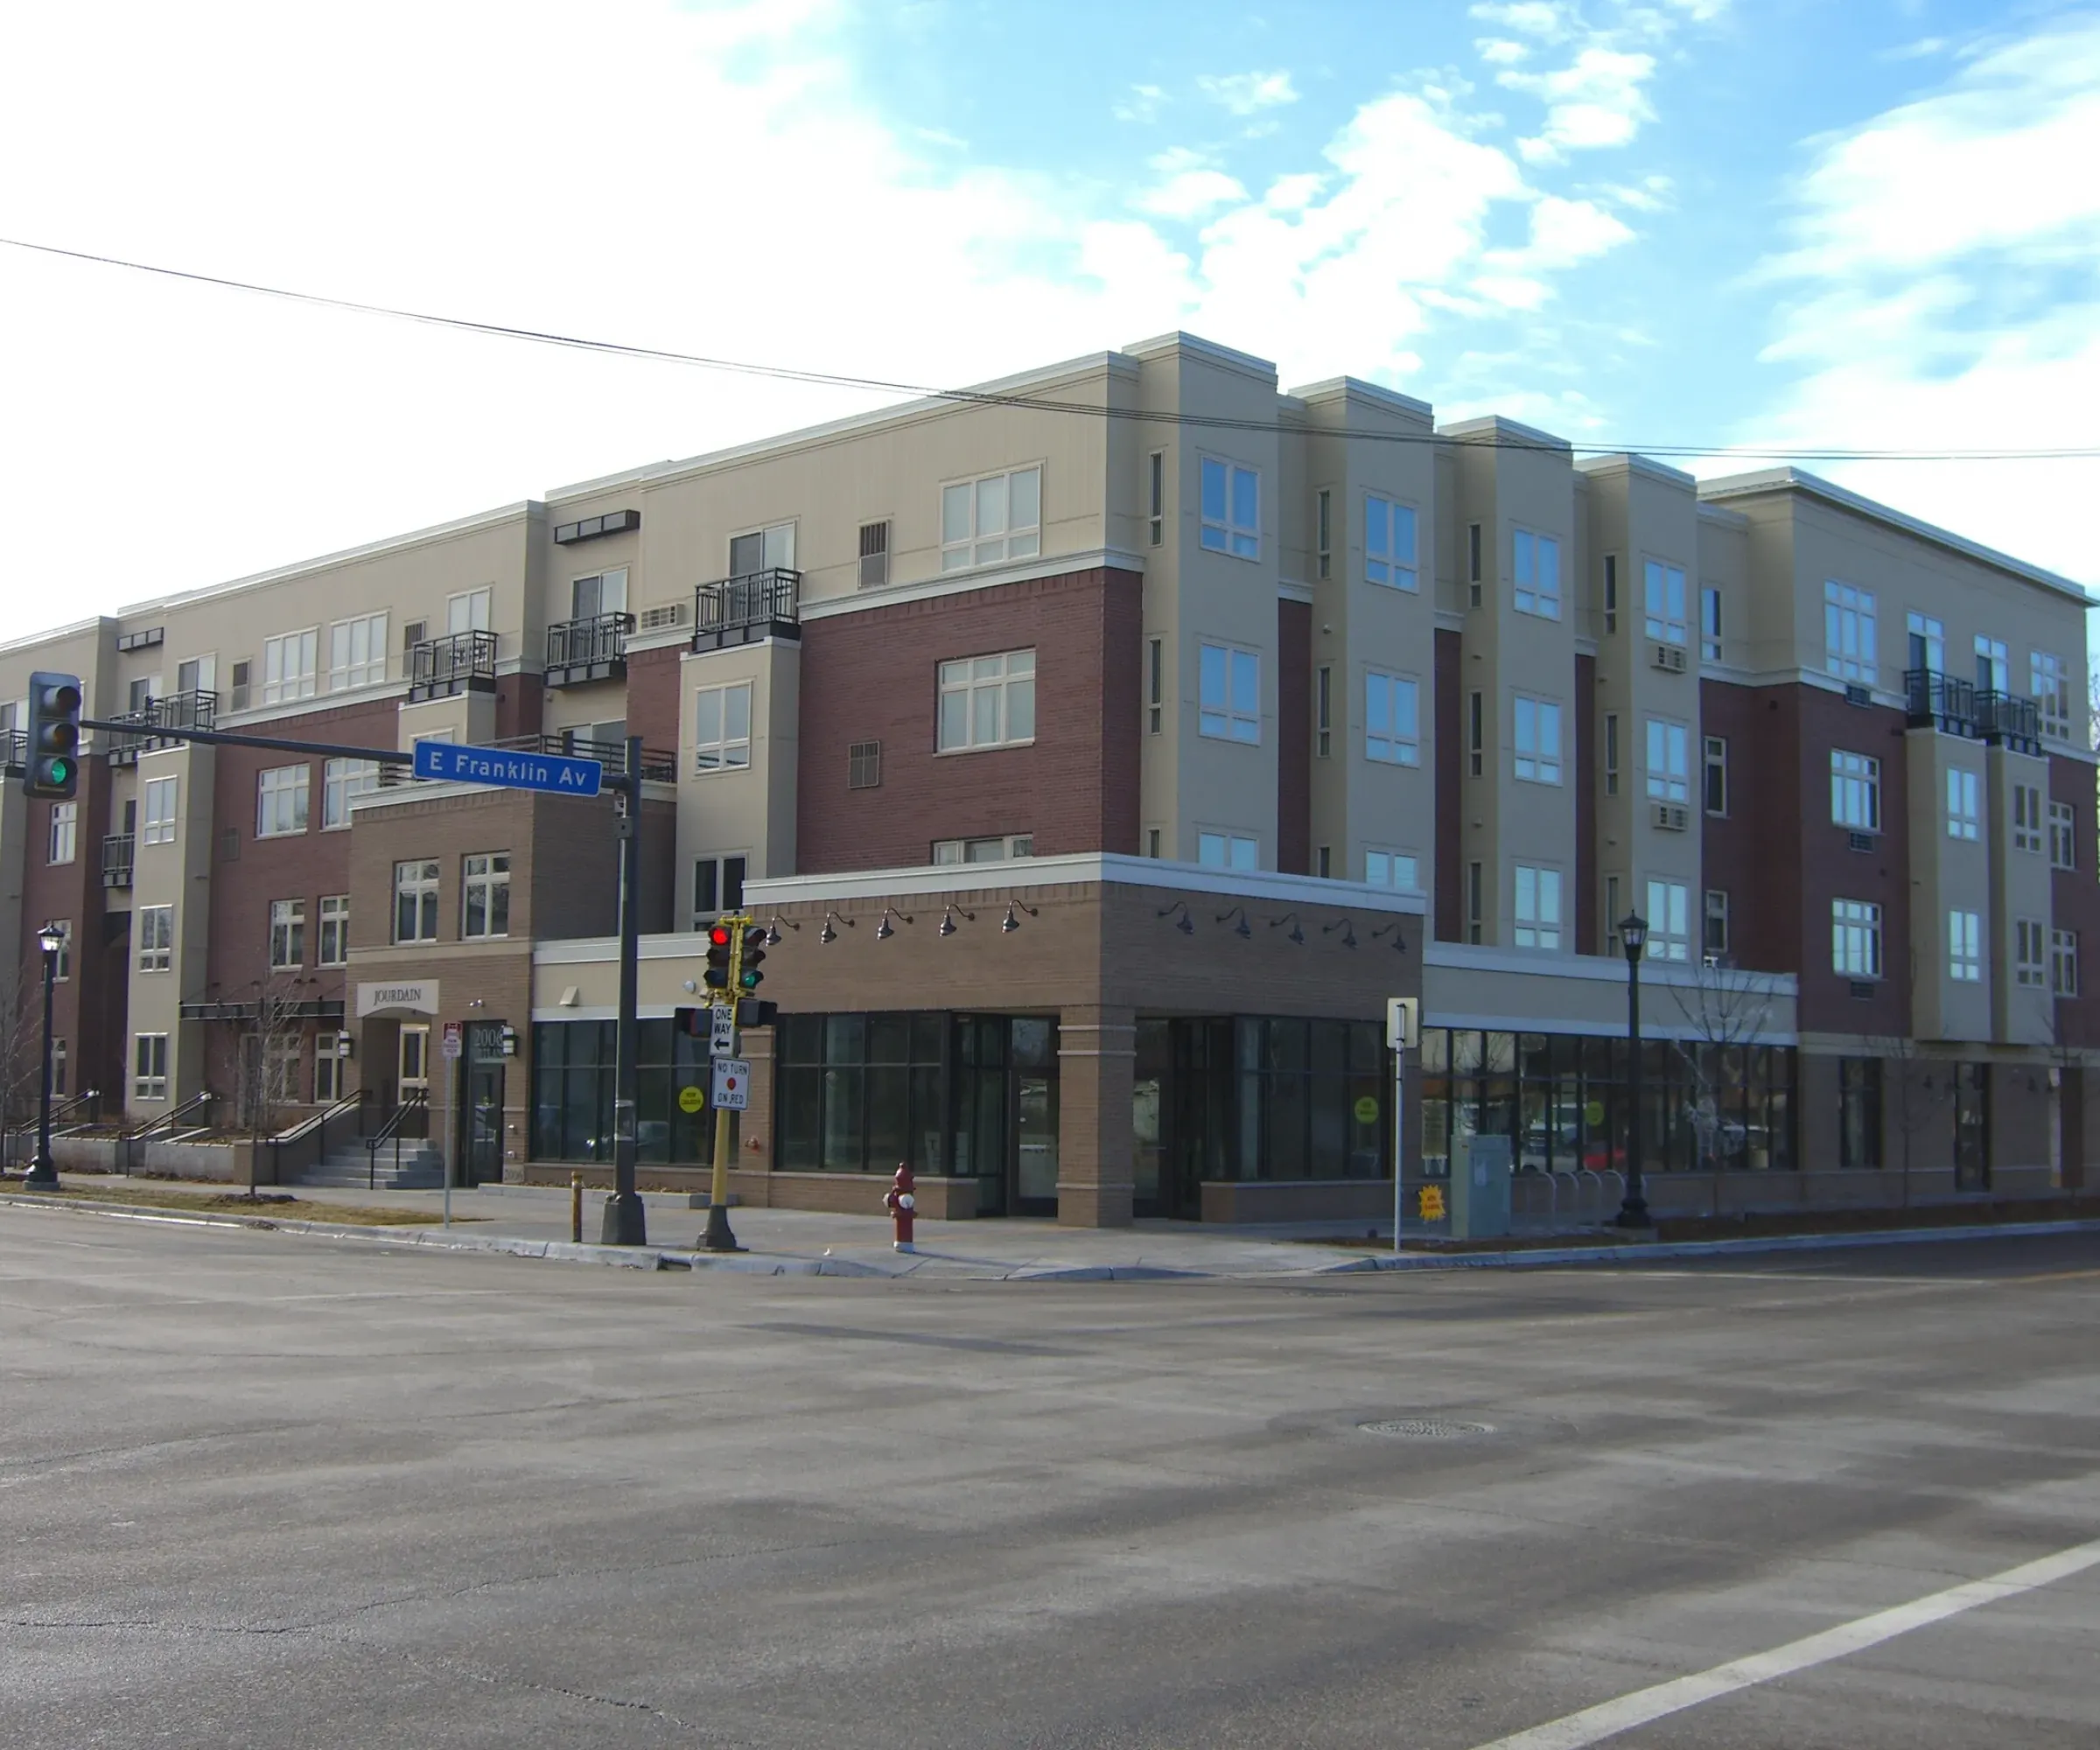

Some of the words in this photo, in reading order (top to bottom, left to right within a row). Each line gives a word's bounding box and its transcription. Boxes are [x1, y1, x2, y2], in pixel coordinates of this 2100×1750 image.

[430, 752, 443, 771] E
[456, 754, 547, 782] Franklin
[558, 766, 587, 786] Av
[373, 988, 422, 1007] JOURDAIN
[715, 1008, 732, 1020] ONE
[714, 1023, 732, 1034] WAY
[718, 1063, 727, 1074] NO
[731, 1063, 747, 1075] TURN
[718, 1093, 727, 1103] ON
[730, 1094, 744, 1104] RED
